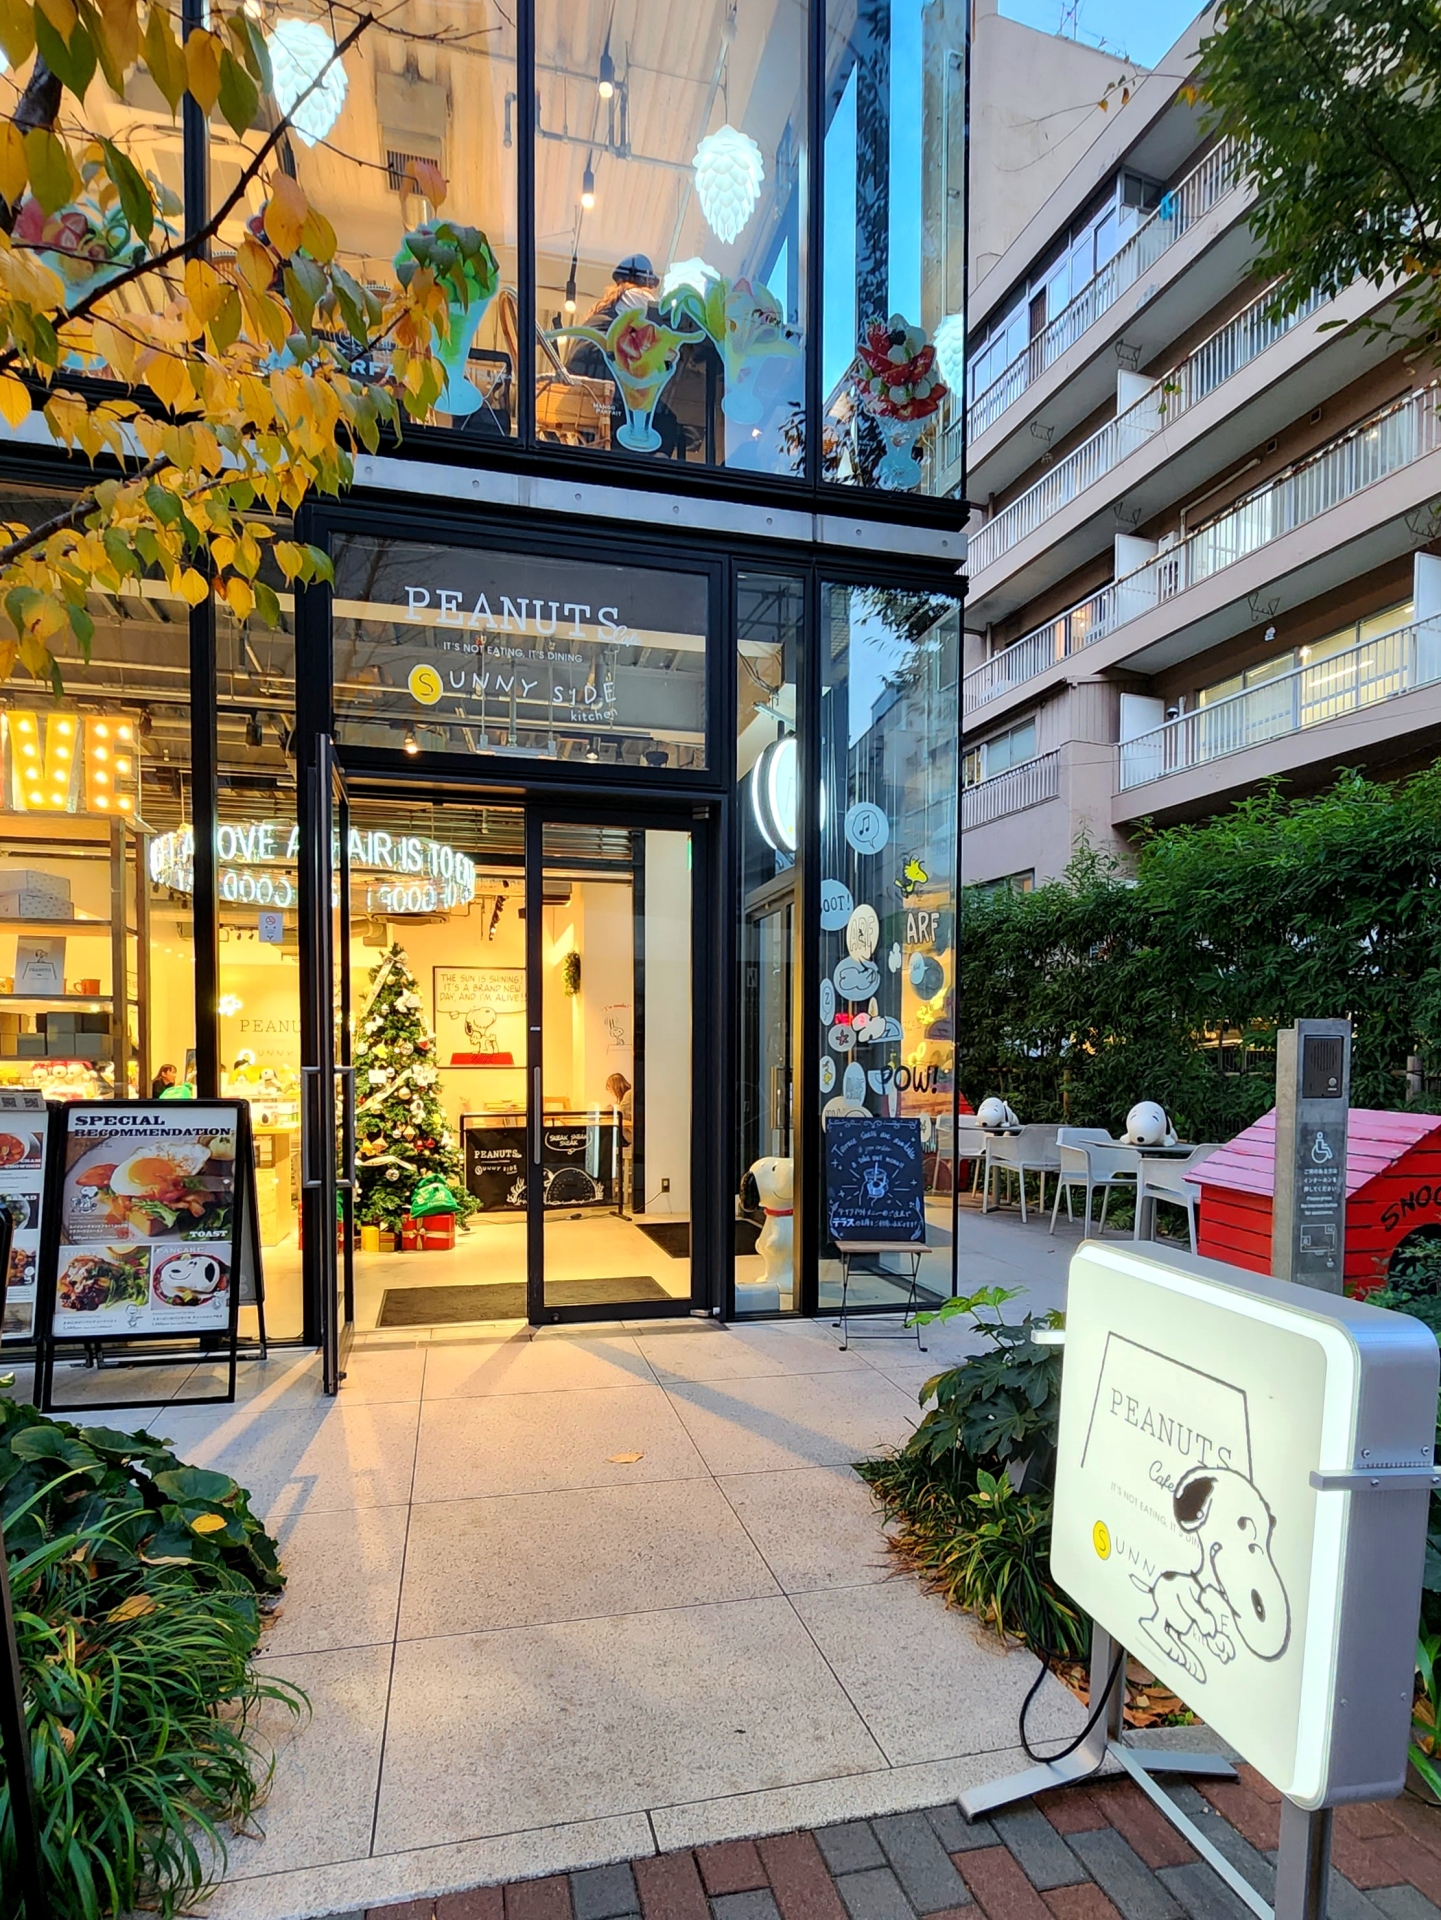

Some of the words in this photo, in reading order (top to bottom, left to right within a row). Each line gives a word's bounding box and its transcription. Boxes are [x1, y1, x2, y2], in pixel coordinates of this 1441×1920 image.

[596, 407, 622, 416] PARFAIT
[404, 586, 618, 641] PEANUTS
[443, 641, 460, 651] IT'S
[463, 643, 484, 653] NOT
[487, 646, 526, 658] EATING,
[528, 649, 545, 660] IT'S
[549, 651, 583, 664] DINING
[570, 708, 618, 722] kitchen
[2, 710, 136, 816] VE
[216, 825, 276, 861] OVE
[401, 836, 423, 872] IS
[428, 843, 453, 879] TO
[822, 893, 850, 913] OOT!
[906, 911, 940, 945] ARF
[440, 973, 456, 982] THE
[460, 974, 475, 983] SUN
[478, 975, 487, 983] IS
[489, 975, 524, 984] SHINING!
[444, 983, 460, 992] IT'S
[463, 984, 469, 992] A
[473, 984, 501, 992] BRAND
[503, 985, 521, 993] NEW
[459, 993, 476, 1001] AND
[480, 993, 492, 1001] I'M
[240, 1019, 301, 1033] PEANU
[880, 1065, 938, 1095] POW!
[74, 1115, 165, 1126] SPECIAL
[74, 1127, 231, 1137] RECOMMENDATION
[474, 1149, 519, 1159] PEANUTS
[156, 1246, 204, 1254] PANCAKE
[1110, 1387, 1232, 1469] PEANUTS
[1148, 1460, 1176, 1492] Cafe
[1124, 1490, 1138, 1506] NOT
[1097, 1529, 1156, 1577] SUNN
